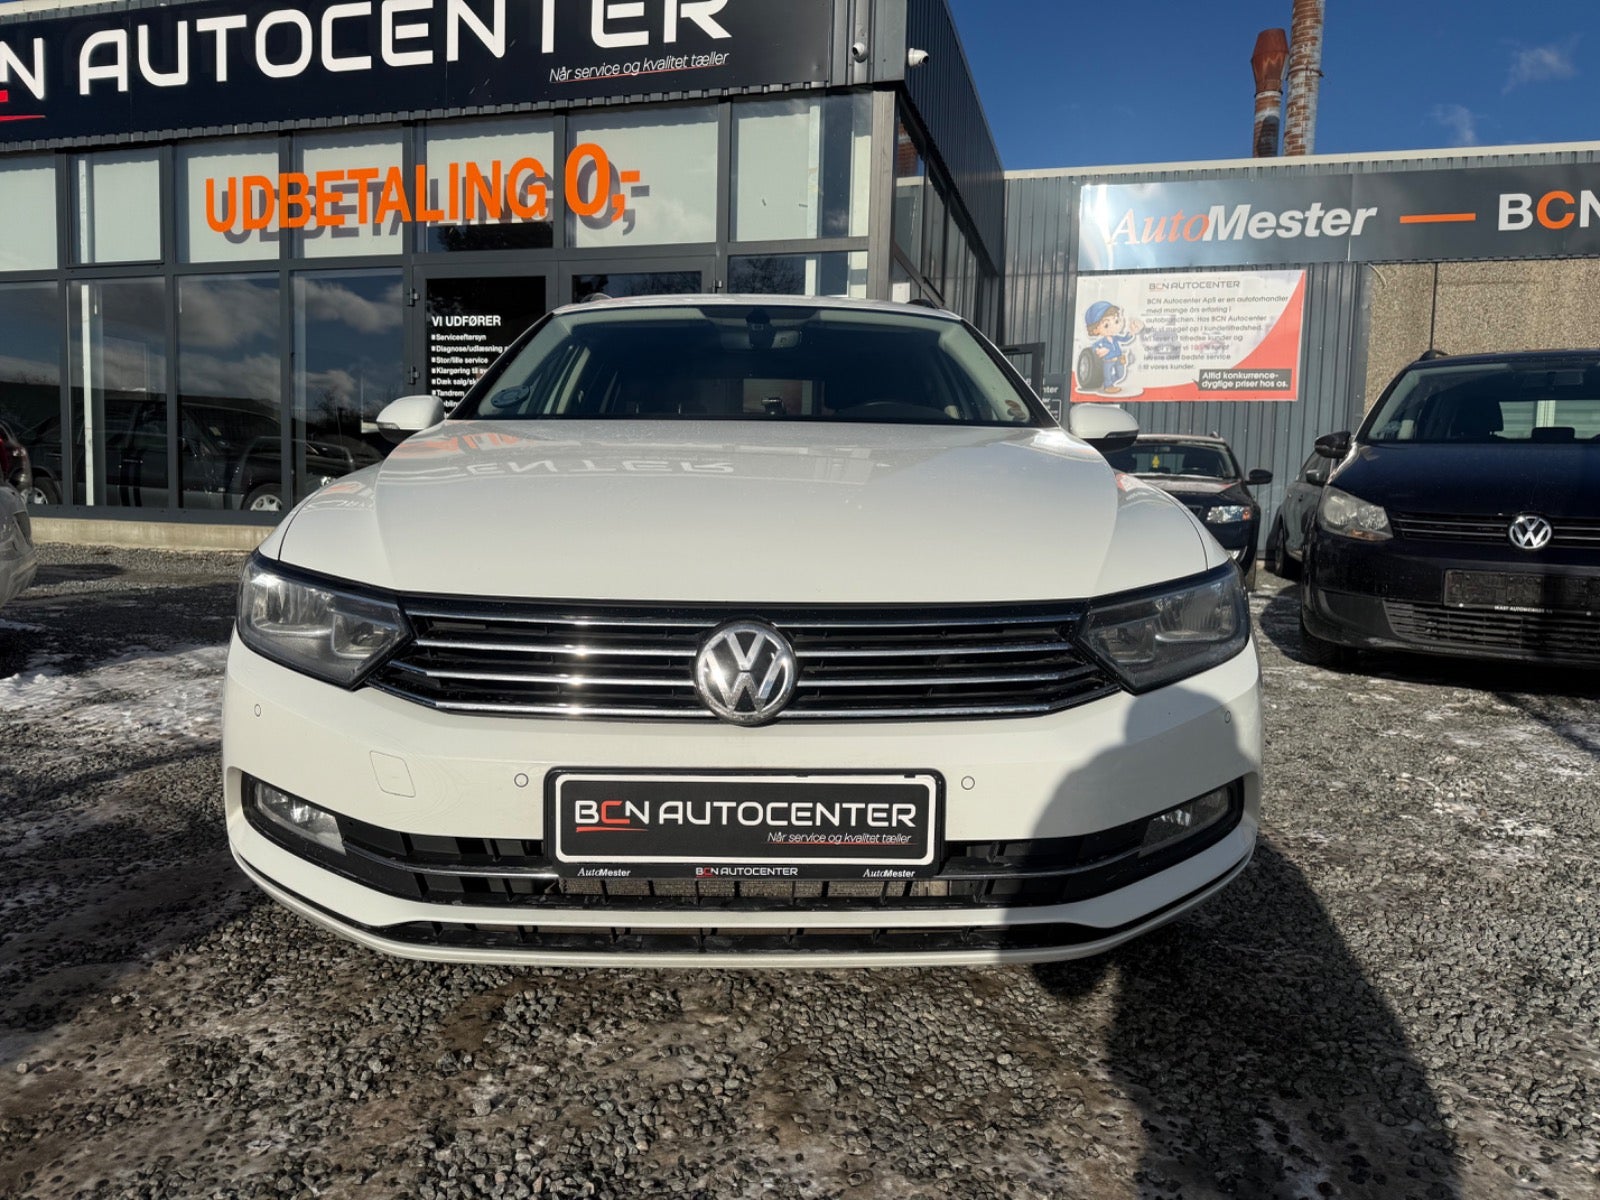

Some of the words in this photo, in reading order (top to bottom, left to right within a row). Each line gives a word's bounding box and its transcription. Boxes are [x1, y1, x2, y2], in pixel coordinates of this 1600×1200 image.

[550, 66, 572, 81] Når
[574, 63, 620, 80] service
[623, 62, 640, 76] og
[643, 54, 688, 71] kvalitet
[691, 51, 730, 66] tæller
[205, 157, 547, 233] UDBETALING
[1110, 202, 1378, 245] AutoMester
[1149, 282, 1169, 290] BCN
[1171, 280, 1240, 289] AUTOCENTER
[1237, 295, 1288, 303] autoforhandler
[431, 316, 443, 327] VI
[445, 315, 502, 327] UDFØRER
[1201, 380, 1234, 388] dygtige
[1235, 380, 1259, 388] priser
[1260, 379, 1274, 387] hos
[575, 800, 650, 824] BCN
[659, 801, 917, 828] AUTOCENTER
[767, 832, 786, 843] Når
[788, 832, 826, 843] service
[828, 835, 842, 845] og
[844, 832, 880, 843] kvalitet
[882, 833, 911, 844] tæller
[577, 867, 631, 877] AutoMester
[695, 867, 719, 876] BCN
[720, 866, 798, 876] AUTOCENTER
[862, 868, 916, 878] AutoMester
